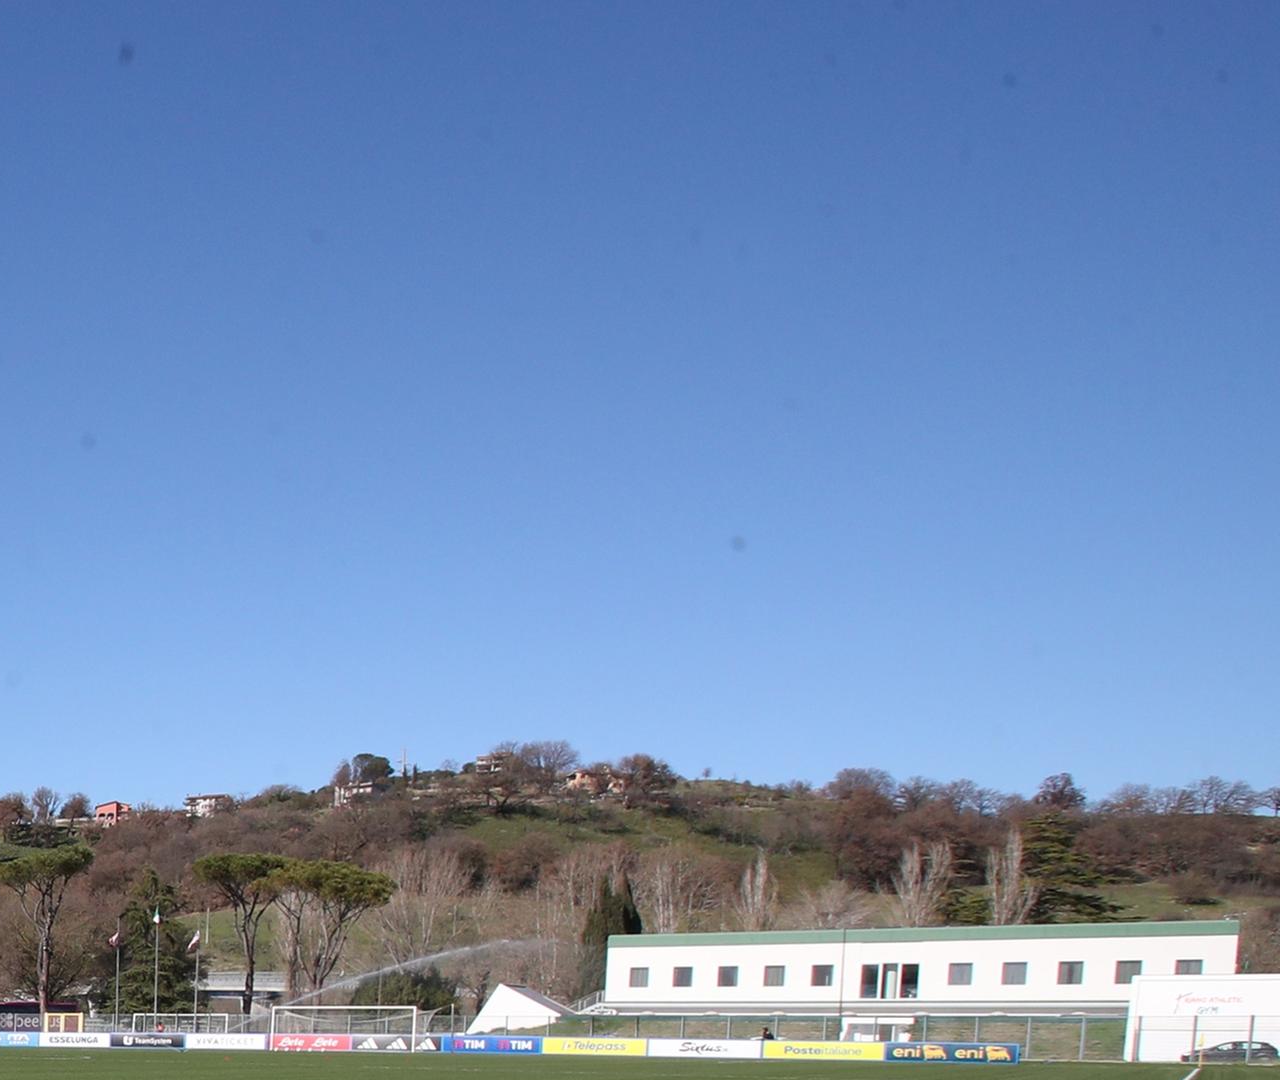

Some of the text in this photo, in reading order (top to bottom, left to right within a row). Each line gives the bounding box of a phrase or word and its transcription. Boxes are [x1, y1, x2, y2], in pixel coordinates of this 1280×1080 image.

[49, 1036, 99, 1044] ESSELUNGA
[134, 1036, 172, 1046] TeamSystem
[278, 1037, 339, 1047] Lete Lete
[464, 1039, 533, 1050] TIM TIM
[573, 1040, 627, 1052] Telepass
[893, 1045, 984, 1060] eni eni
